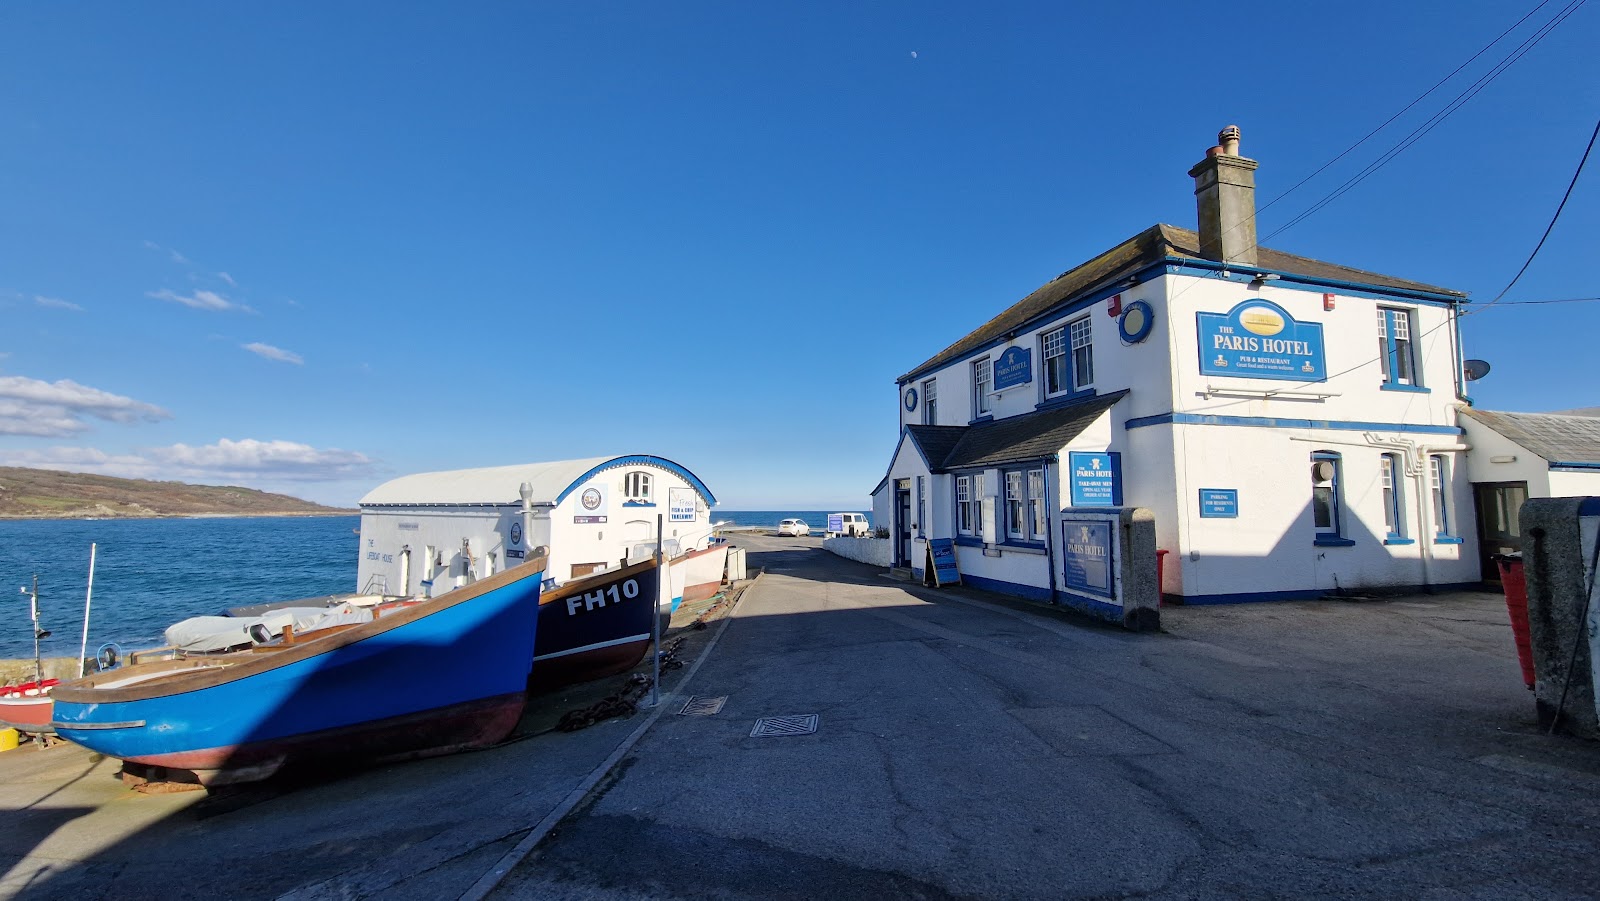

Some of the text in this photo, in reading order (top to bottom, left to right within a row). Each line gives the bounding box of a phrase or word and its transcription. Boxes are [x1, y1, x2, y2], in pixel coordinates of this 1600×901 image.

[1219, 326, 1234, 334] THE
[1213, 334, 1313, 356] PARIS HOTEL
[1010, 361, 1027, 372] HOTEL
[1258, 357, 1290, 365] RESTAURANT
[1067, 543, 1106, 556] PARIS HOTEL
[566, 579, 638, 616] FH10
